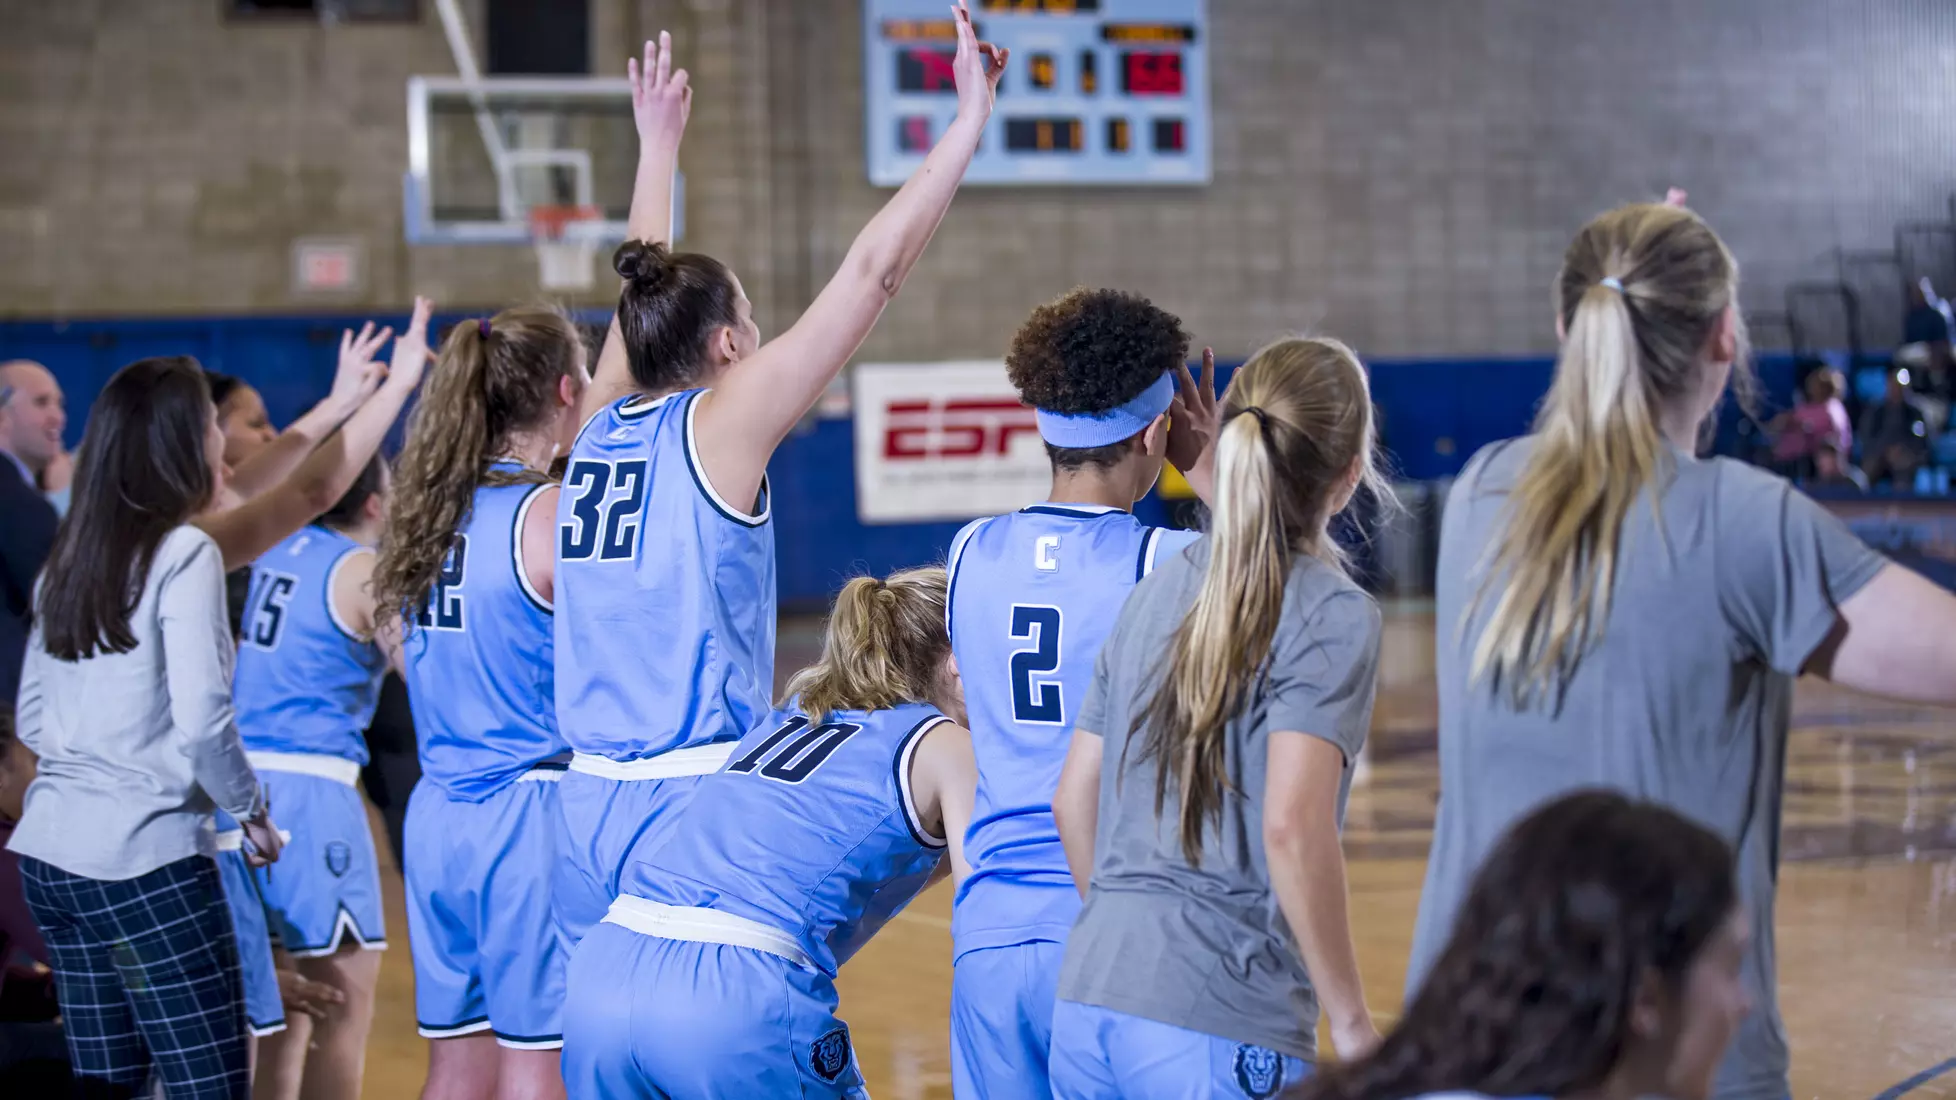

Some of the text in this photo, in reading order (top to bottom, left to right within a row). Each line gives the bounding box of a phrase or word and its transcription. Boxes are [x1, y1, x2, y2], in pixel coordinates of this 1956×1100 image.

[885, 398, 1039, 460] ESP
[560, 458, 647, 562] 32
[417, 533, 470, 632] 2
[1035, 535, 1060, 571] C
[1008, 603, 1065, 726] 2
[724, 714, 863, 785] 10
